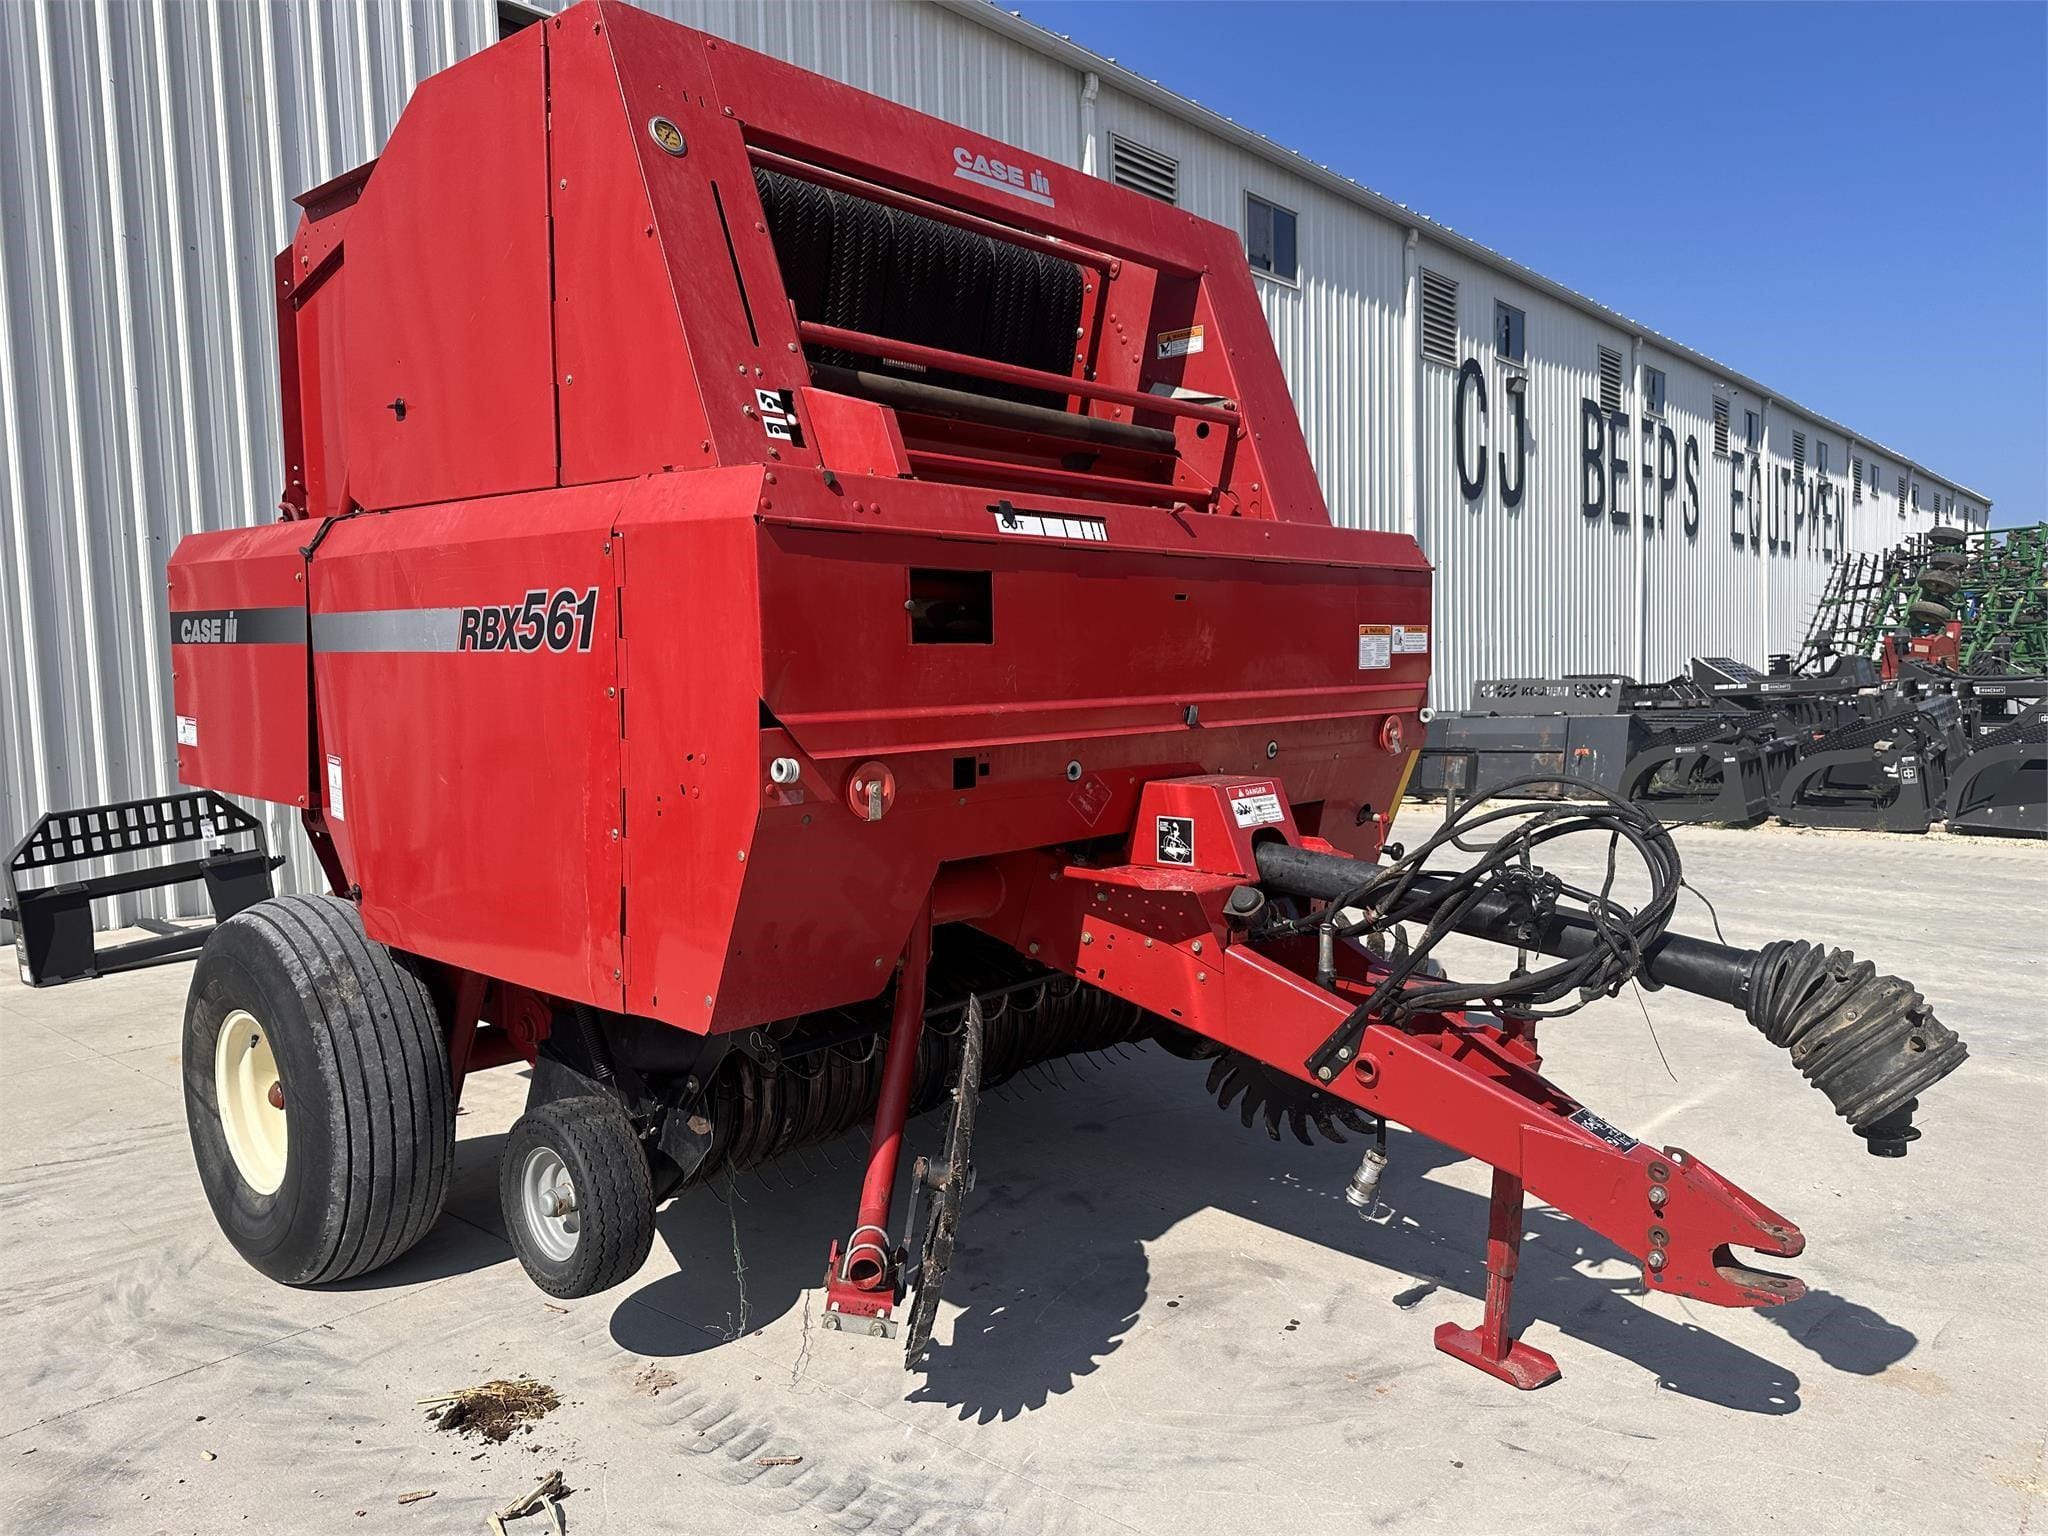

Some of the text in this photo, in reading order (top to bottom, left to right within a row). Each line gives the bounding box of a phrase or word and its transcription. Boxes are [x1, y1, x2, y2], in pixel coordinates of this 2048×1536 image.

[953, 147, 1024, 187] CASE
[1456, 358, 1526, 508] CJ
[1582, 397, 1699, 538] BEEPS
[181, 618, 221, 643] CASE
[458, 586, 599, 653] RBX561
